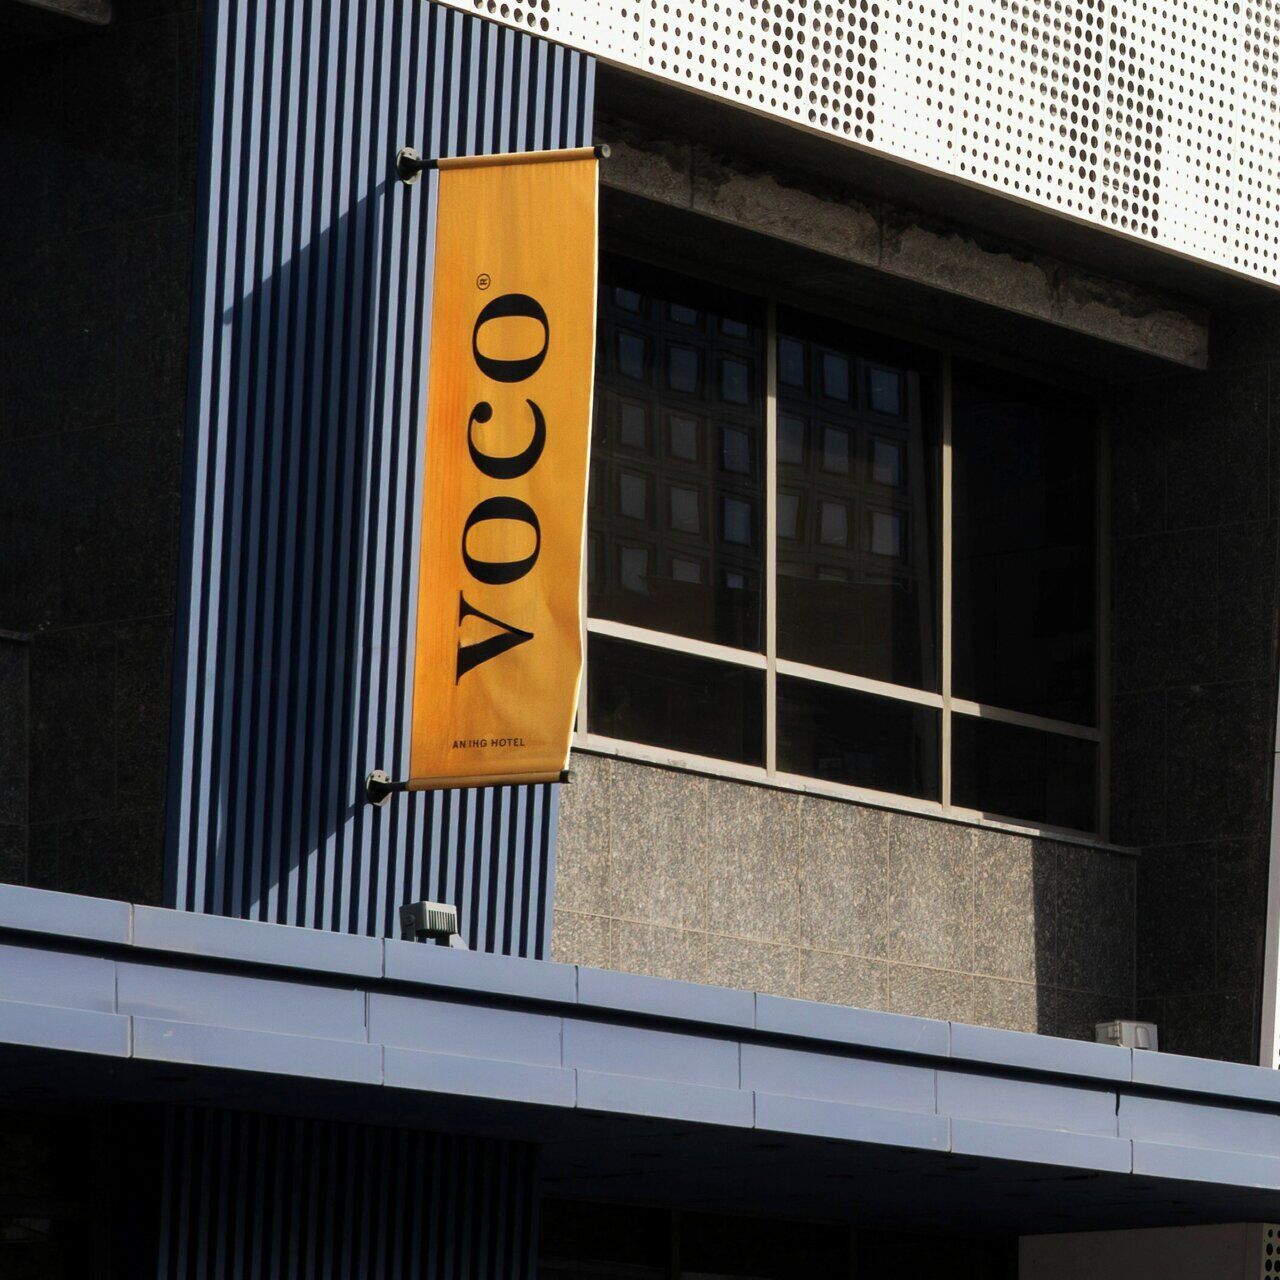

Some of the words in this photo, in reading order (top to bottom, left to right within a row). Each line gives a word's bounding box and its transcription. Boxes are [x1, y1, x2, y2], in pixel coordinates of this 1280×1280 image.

[452, 740, 466, 749] AN
[469, 739, 488, 748] IHG
[491, 738, 525, 747] HOTEL
